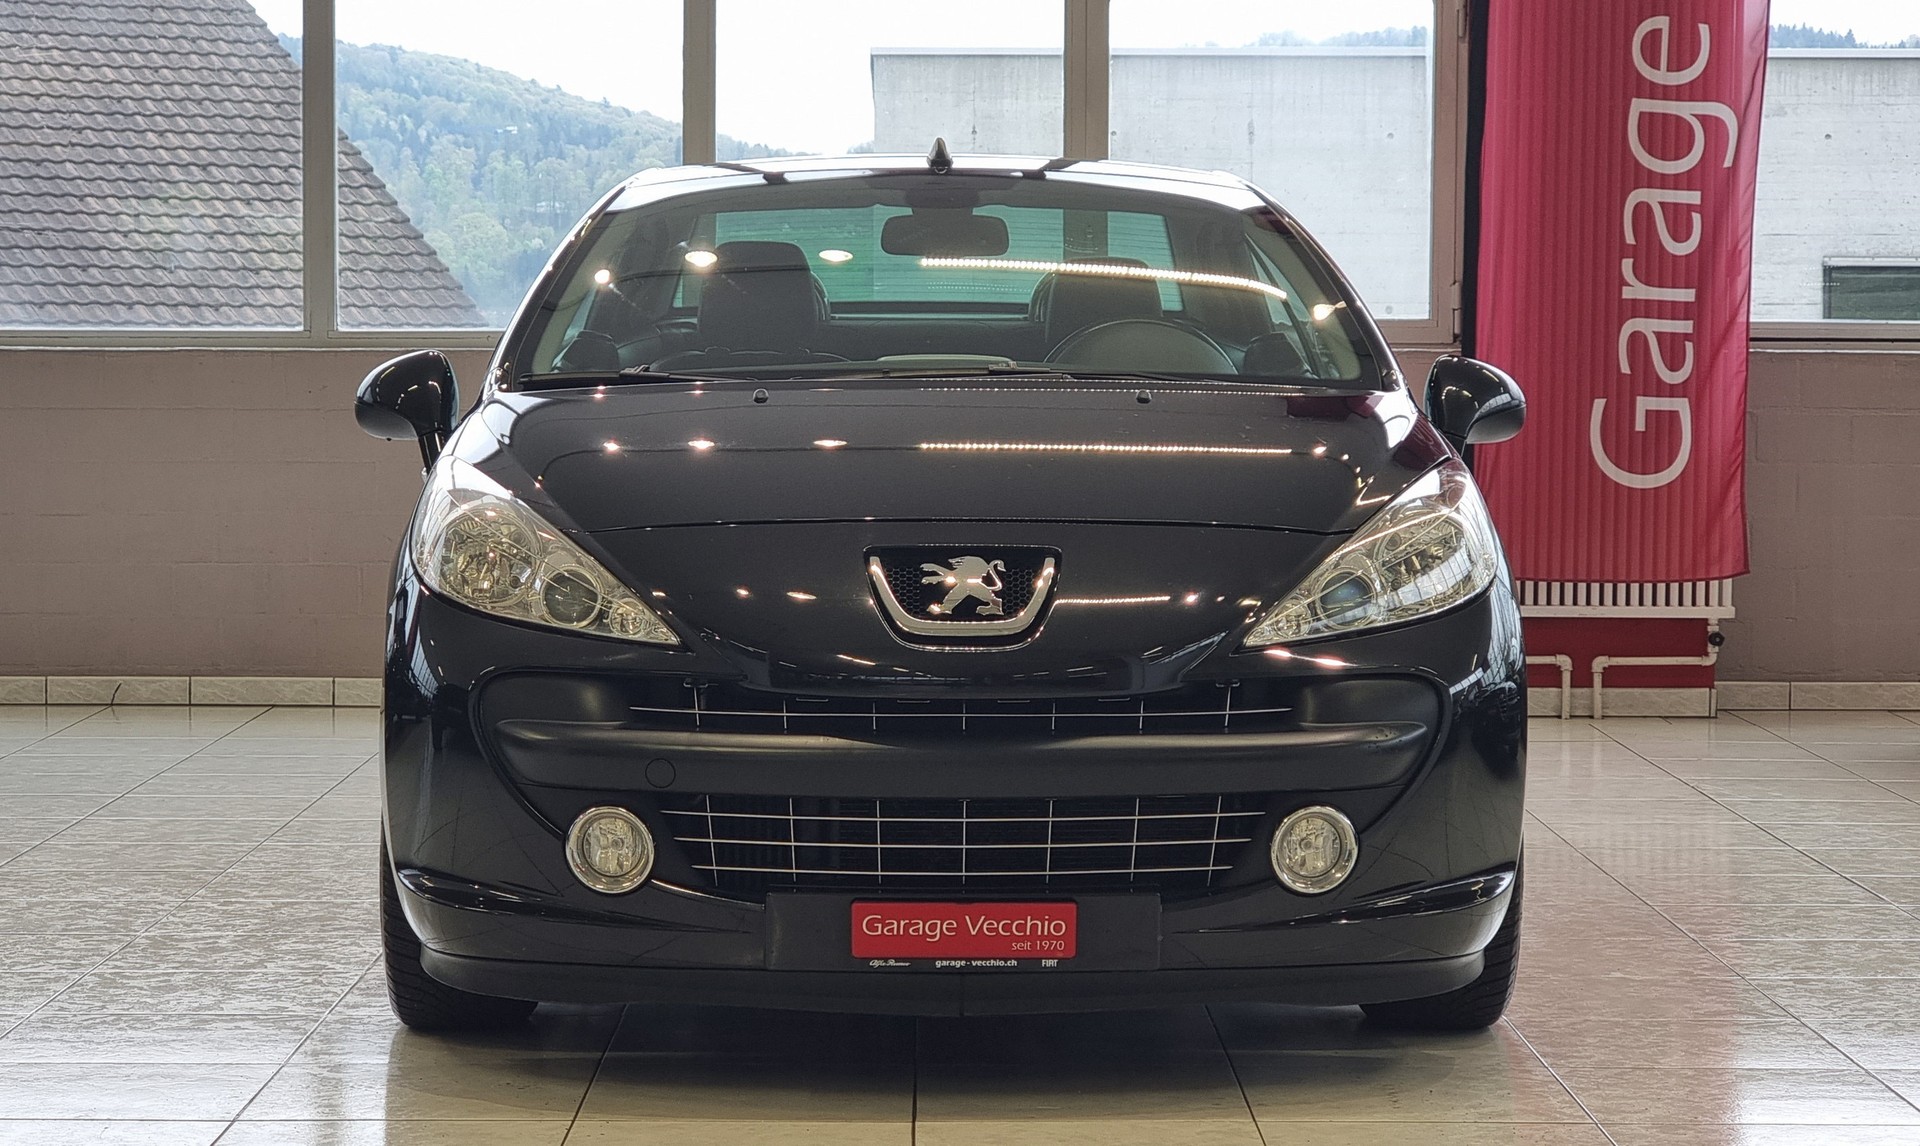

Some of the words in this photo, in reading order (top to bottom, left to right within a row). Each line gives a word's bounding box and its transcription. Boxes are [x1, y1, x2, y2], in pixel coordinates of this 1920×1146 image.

[1590, 15, 1739, 489] Garage
[862, 915, 957, 942] Garage
[965, 915, 1066, 936] Vecchio
[1011, 940, 1032, 951] seit
[1036, 940, 1065, 951] 1970
[1041, 959, 1058, 968] FIAT
